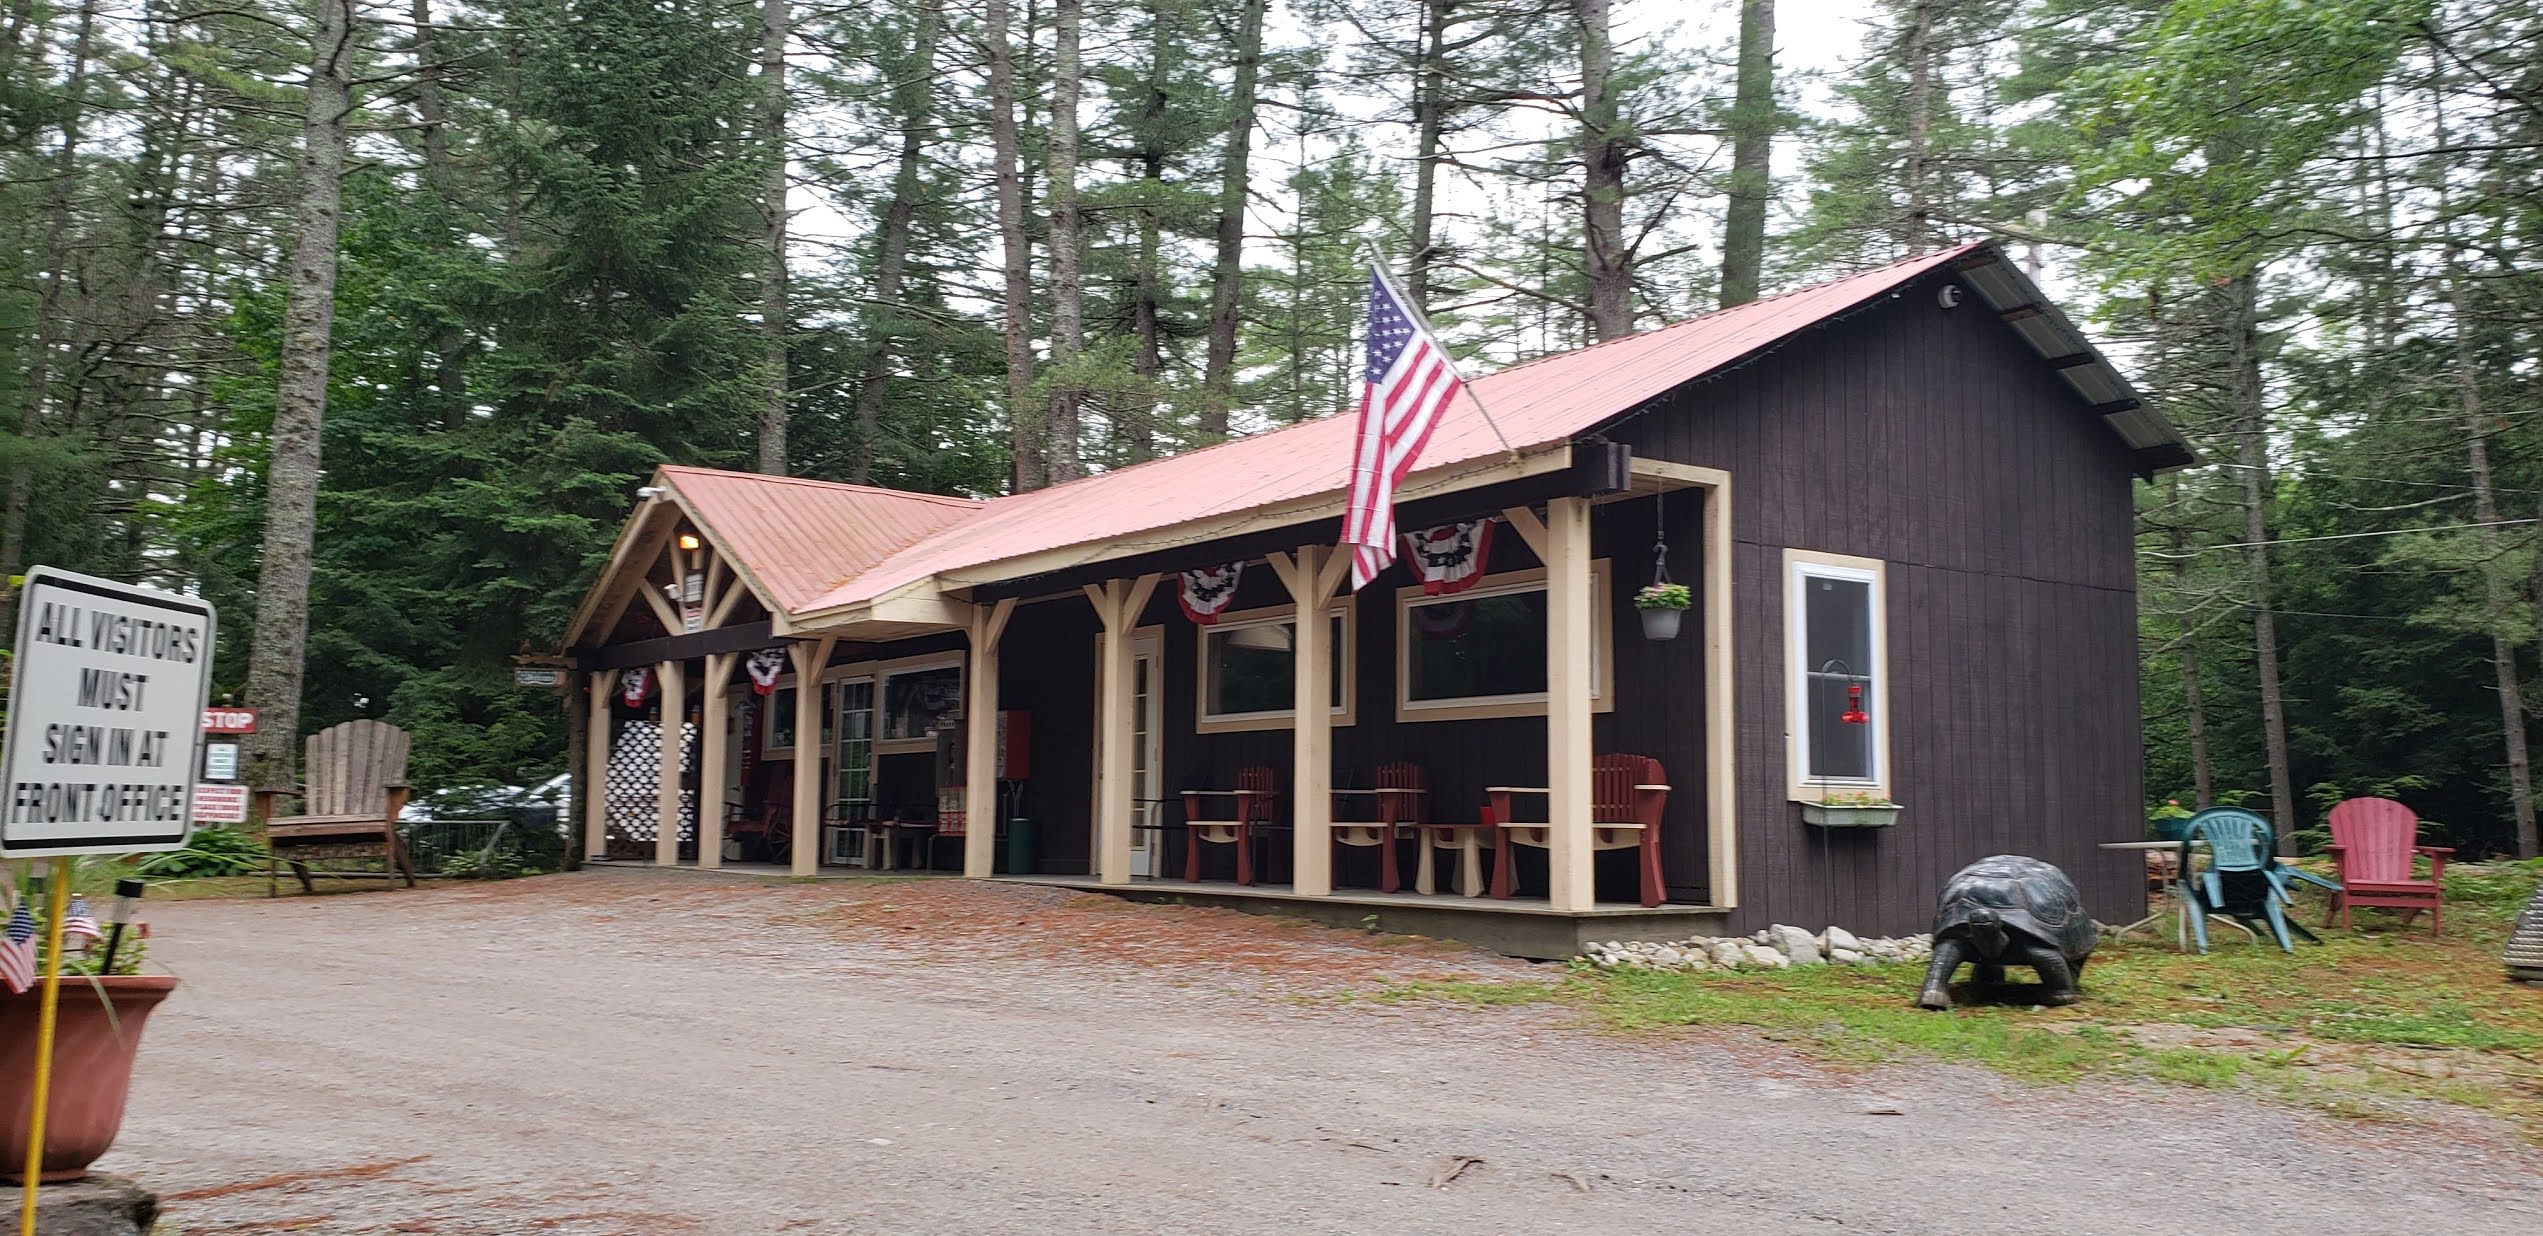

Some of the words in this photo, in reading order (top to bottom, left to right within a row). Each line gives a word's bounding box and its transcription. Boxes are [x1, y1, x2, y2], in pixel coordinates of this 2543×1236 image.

[36, 602, 82, 647] ALL
[92, 611, 199, 663] VISITORS
[77, 667, 148, 711] MUST
[202, 711, 255, 728] STOP
[43, 723, 104, 764] SIGN
[107, 728, 134, 766] IN
[136, 730, 169, 767] AT
[12, 782, 97, 823] FRONT
[99, 783, 184, 822] OFFICE
